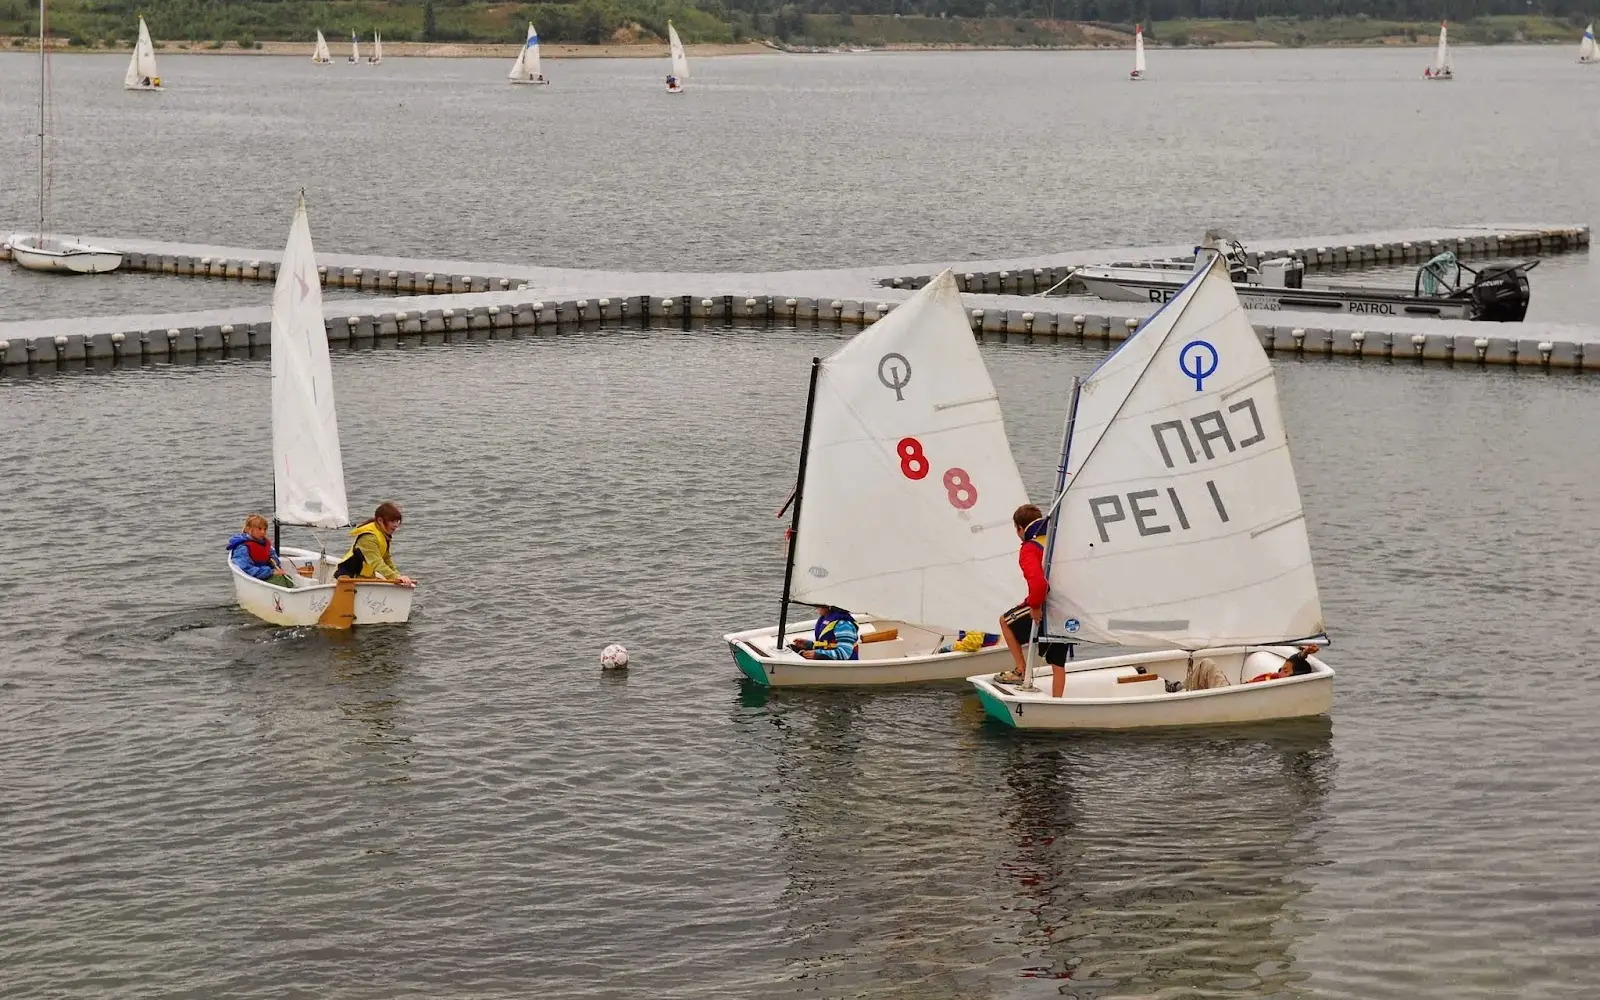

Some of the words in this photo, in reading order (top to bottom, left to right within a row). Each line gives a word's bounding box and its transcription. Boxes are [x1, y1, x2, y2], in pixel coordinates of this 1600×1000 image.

[1243, 302, 1282, 311] ALGARY
[1349, 302, 1397, 315] PATROL
[897, 437, 929, 480] 8
[943, 467, 978, 509] 8
[1015, 703, 1024, 717] 4
